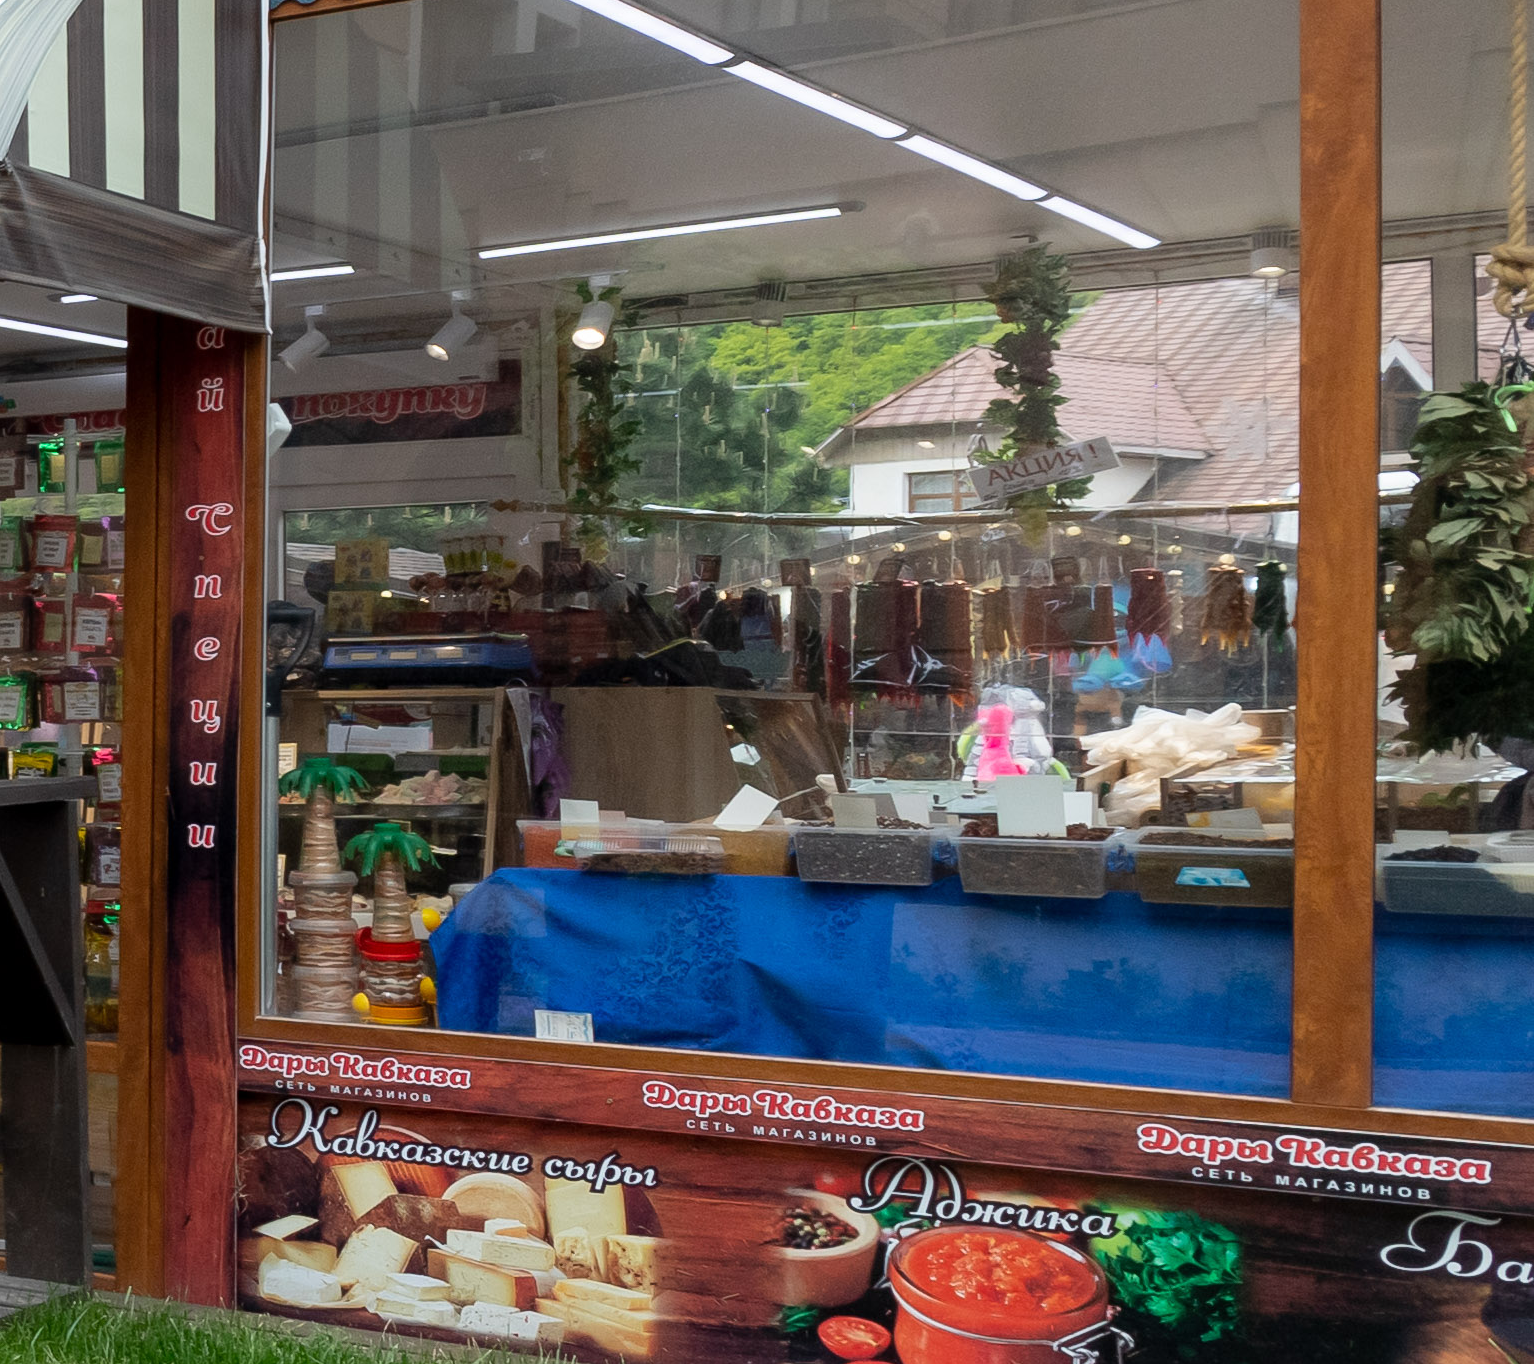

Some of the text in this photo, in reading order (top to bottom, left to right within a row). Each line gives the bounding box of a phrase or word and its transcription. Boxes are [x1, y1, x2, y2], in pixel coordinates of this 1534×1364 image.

[293, 385, 486, 424] покупку
[987, 448, 1083, 486] АКЦИЯ
[186, 503, 233, 848] Специи
[239, 1044, 471, 1089] Дары Кавказа
[274, 1079, 433, 1103] СЕТЬ МАГАЗИНОВ
[643, 1080, 925, 1131] Дары Кавказа
[268, 1098, 657, 1193] Кавказские сыры
[686, 1118, 877, 1146] СЕТЬ МАГАЗИНОВ
[1137, 1123, 1492, 1184] Дары Кавказа
[849, 1156, 1113, 1237] Аджика
[1192, 1166, 1431, 1200] СЕТЬ МАГАЗИНОВ
